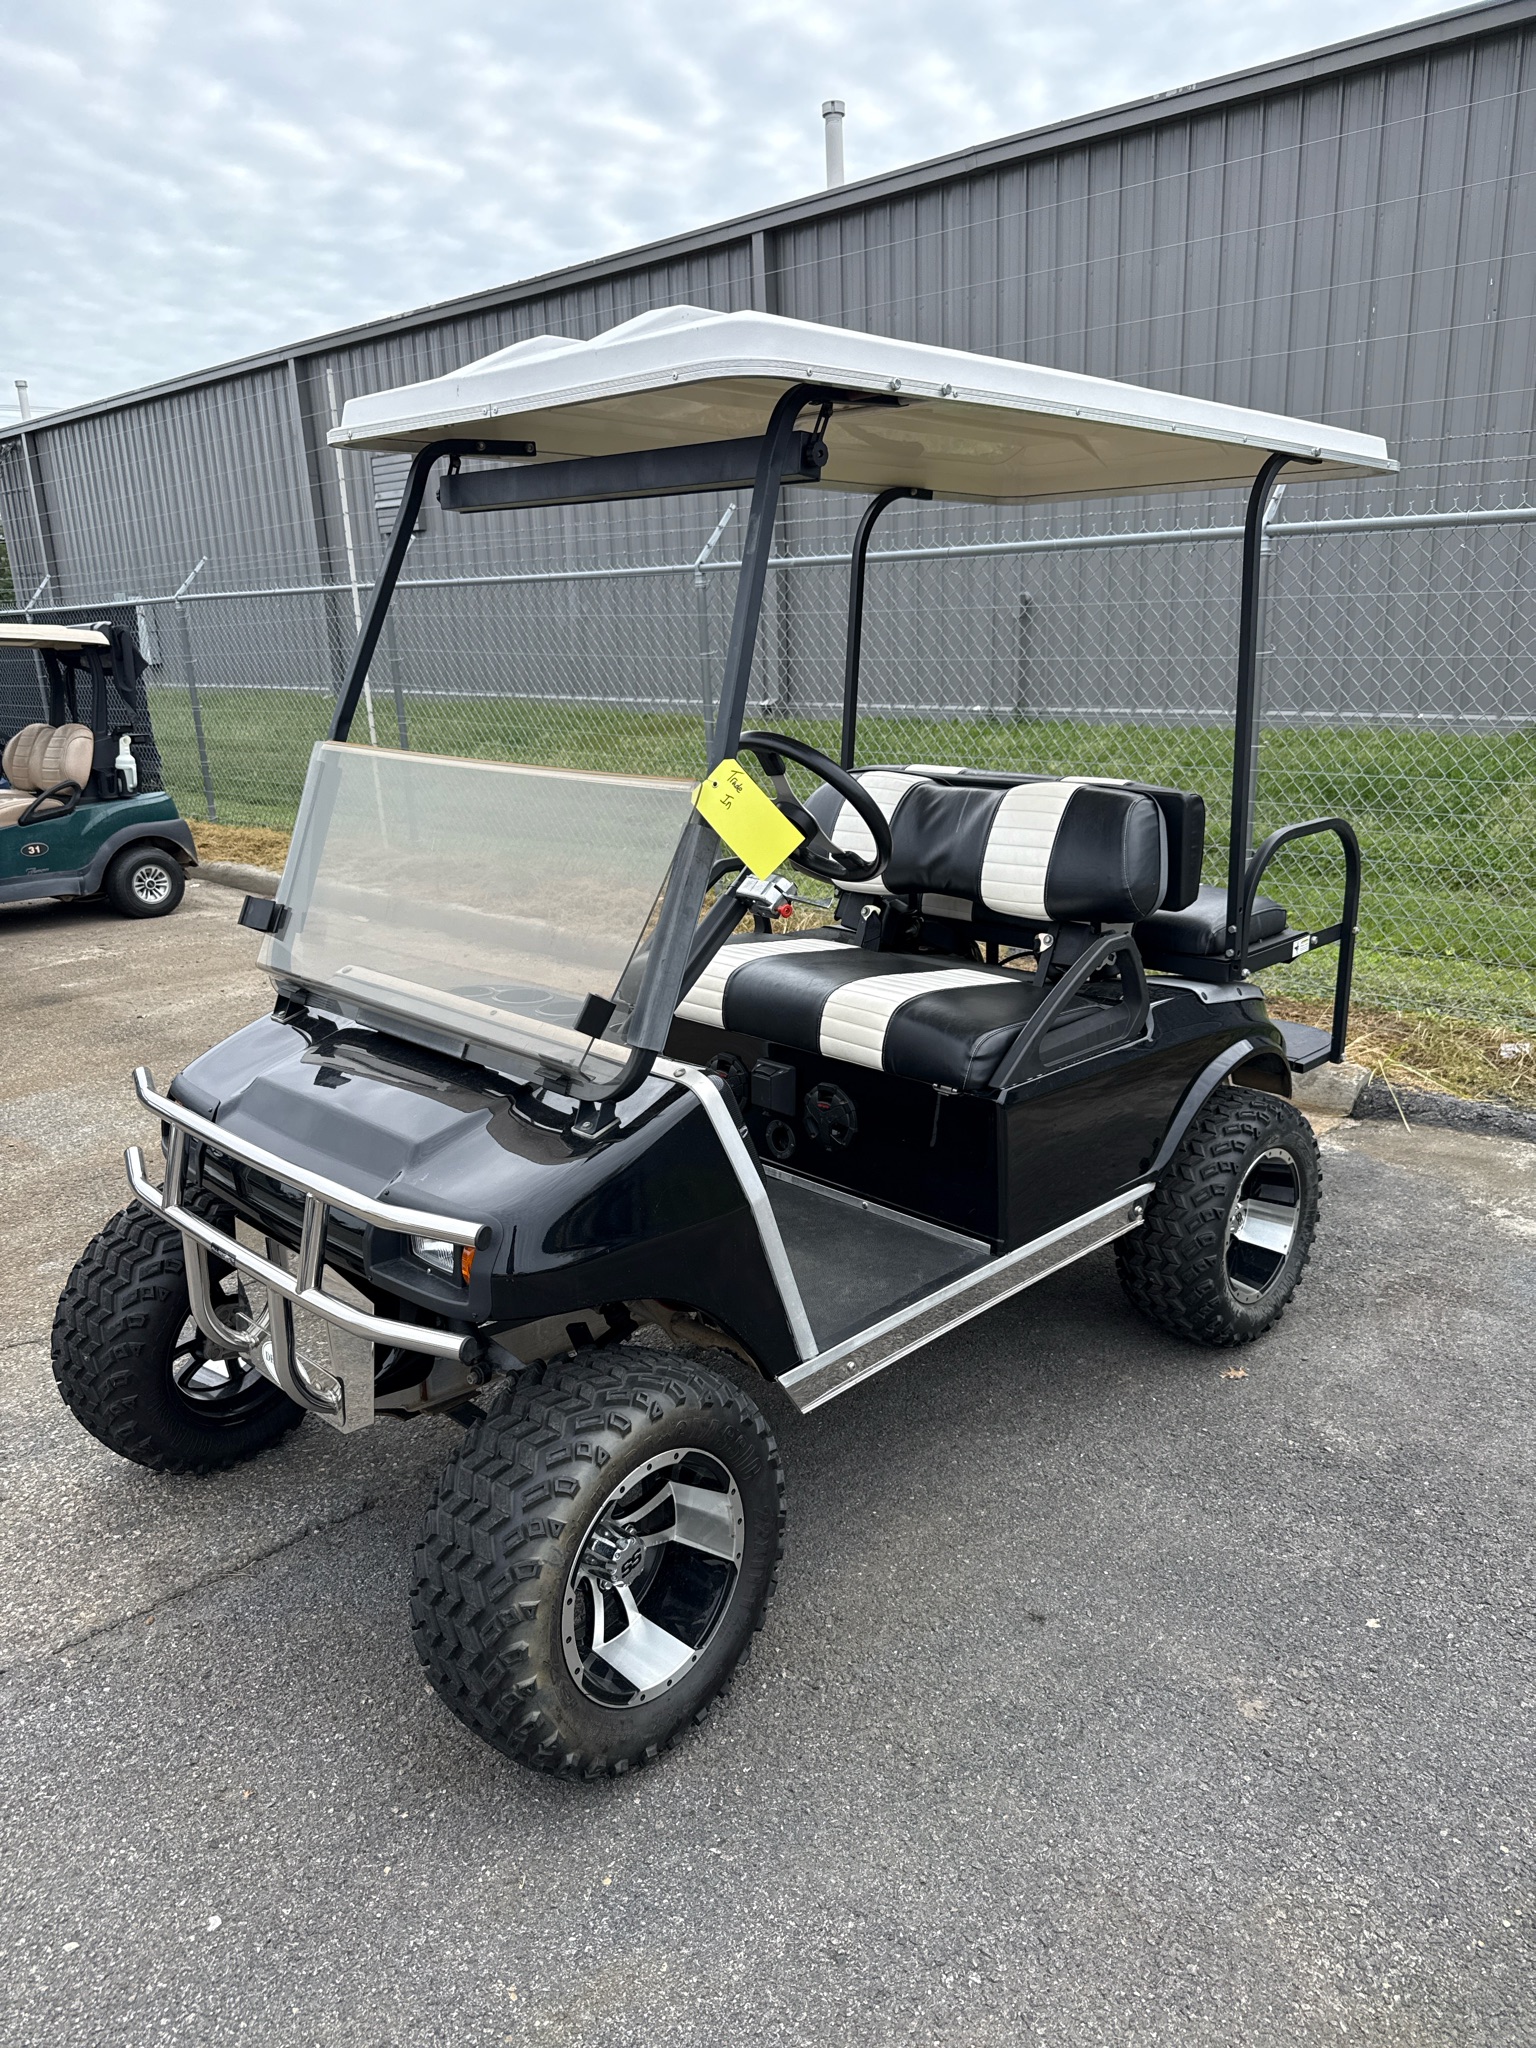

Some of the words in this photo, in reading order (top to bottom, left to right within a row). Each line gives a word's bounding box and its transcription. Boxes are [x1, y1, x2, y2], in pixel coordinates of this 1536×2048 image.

[727, 770, 745, 793] Trade
[720, 794, 735, 810] In
[28, 845, 41, 855] 31
[621, 1548, 642, 1577] SS
